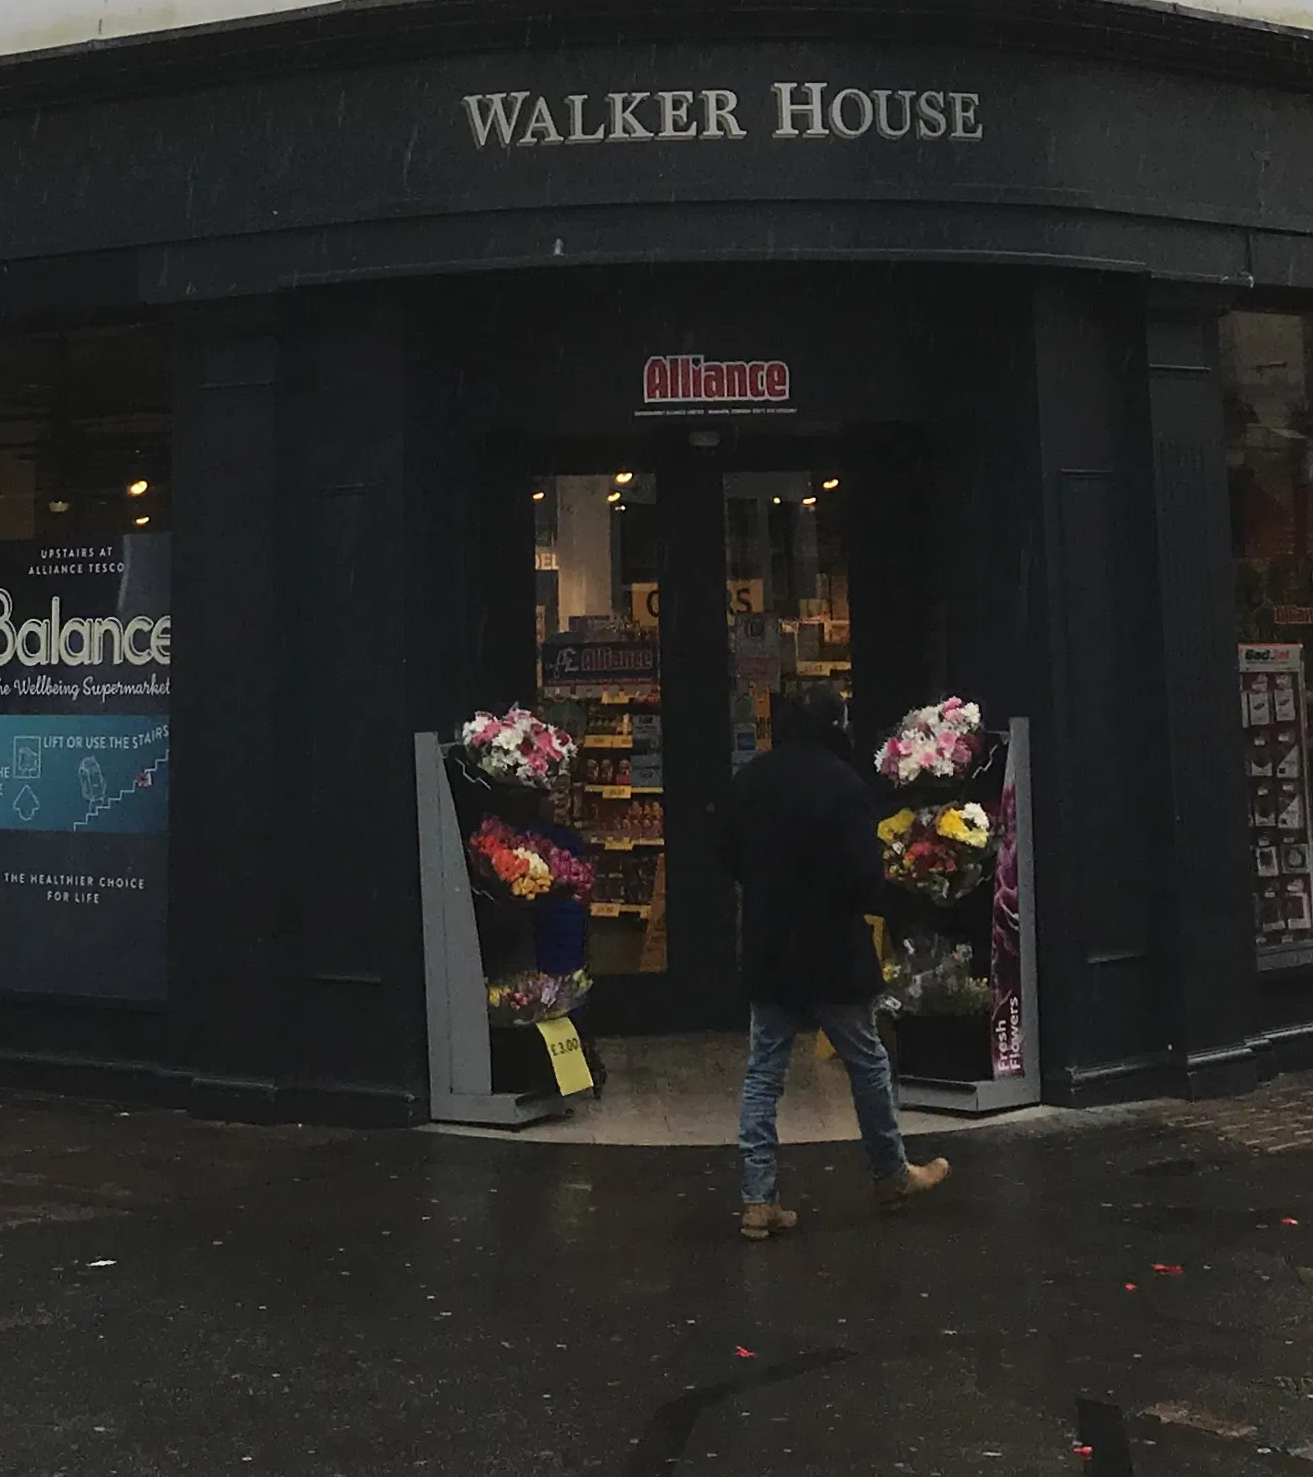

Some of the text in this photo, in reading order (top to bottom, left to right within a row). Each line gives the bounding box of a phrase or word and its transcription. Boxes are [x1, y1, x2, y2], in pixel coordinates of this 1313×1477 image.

[644, 354, 790, 403] Alliance
[40, 546, 113, 559] UPSTAIRS AT
[27, 562, 125, 575] ALLIANCE TESCO
[14, 675, 81, 701] Wellbeing
[83, 674, 171, 703] Supermarket
[43, 724, 170, 750] LIFT OR USE THE STAIRS
[4, 872, 145, 889] THE HEALTHIER CHOICE
[46, 890, 100, 904] FOR LIFE
[995, 1020, 1010, 1072] Fresh
[1009, 996, 1021, 1071] Flowers
